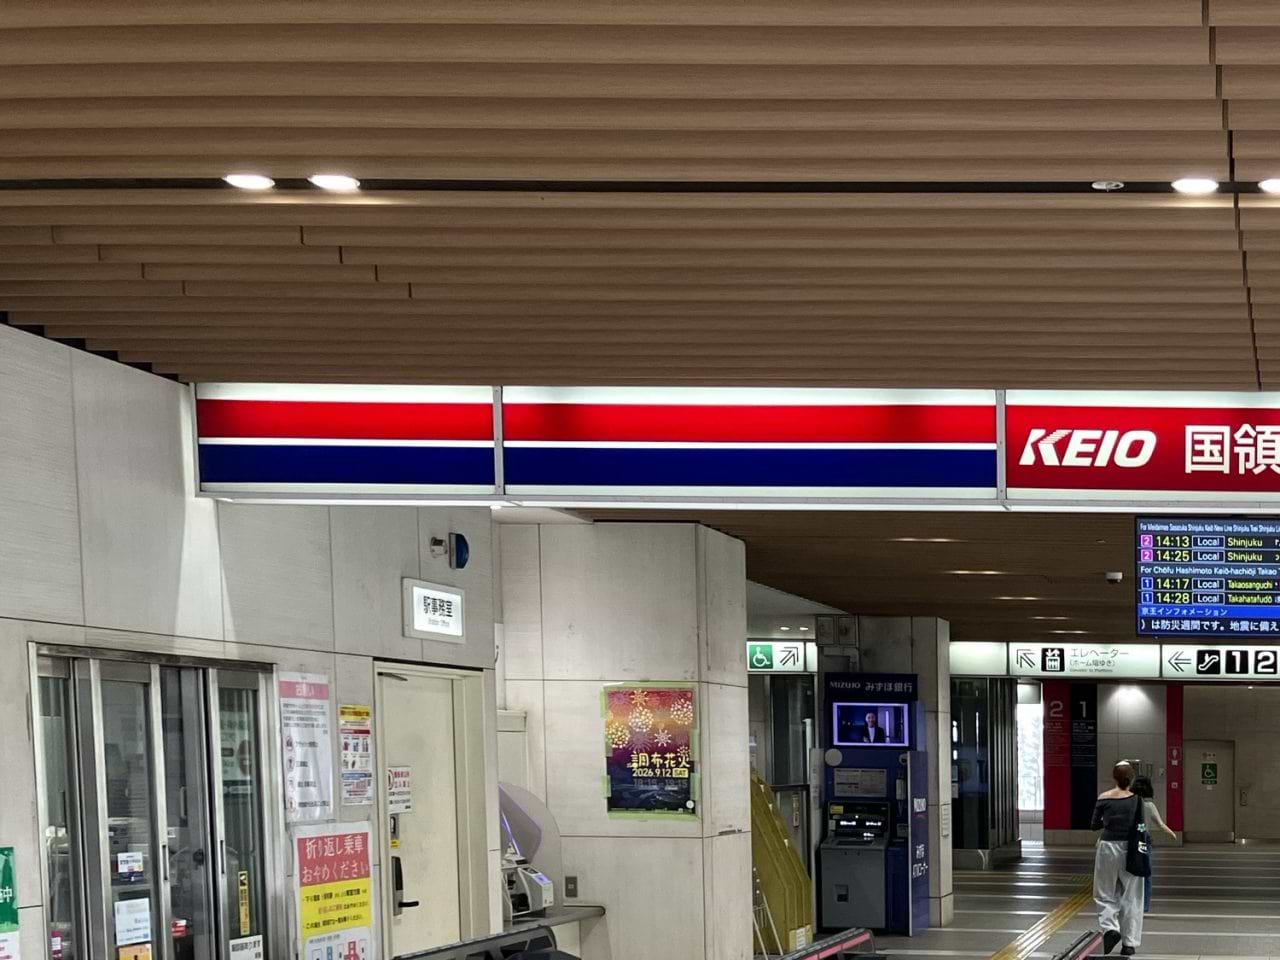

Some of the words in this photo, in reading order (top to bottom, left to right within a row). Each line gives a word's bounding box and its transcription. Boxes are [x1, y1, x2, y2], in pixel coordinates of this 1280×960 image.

[1019, 428, 1157, 468] KEIO
[1143, 537, 1150, 546] 2
[1156, 535, 1190, 547] 14:13
[1197, 537, 1220, 546] Local
[1227, 537, 1263, 548] Shinjuku
[1143, 551, 1150, 560] 2
[1156, 550, 1190, 562] 14:25
[1197, 552, 1220, 561] Local
[1227, 552, 1263, 563] Shinjuku
[1140, 565, 1152, 575] For
[1153, 565, 1175, 575] Chōfu
[1175, 565, 1213, 575] Hashimoto
[1257, 567, 1278, 576] Takao
[1156, 578, 1190, 589] 14:17
[1197, 579, 1220, 589] Local
[1227, 580, 1273, 591] Takaosanguchi
[1156, 592, 1190, 604] 14:28
[1197, 594, 1220, 603] Local
[1141, 607, 1228, 616] 京王インフォメーション
[1070, 648, 1129, 659] エレベーター
[1231, 653, 1242, 673] 1
[1257, 653, 1275, 673] 2
[865, 681, 913, 693] みずほ銀行
[1050, 700, 1064, 717] 2
[1079, 701, 1087, 718] 1
[627, 750, 690, 768] 調布花火
[632, 768, 672, 777] 2026.9.12
[305, 835, 363, 859] 折り返し乗車
[302, 860, 369, 883] おやめください
[0, 886, 13, 902] 中
